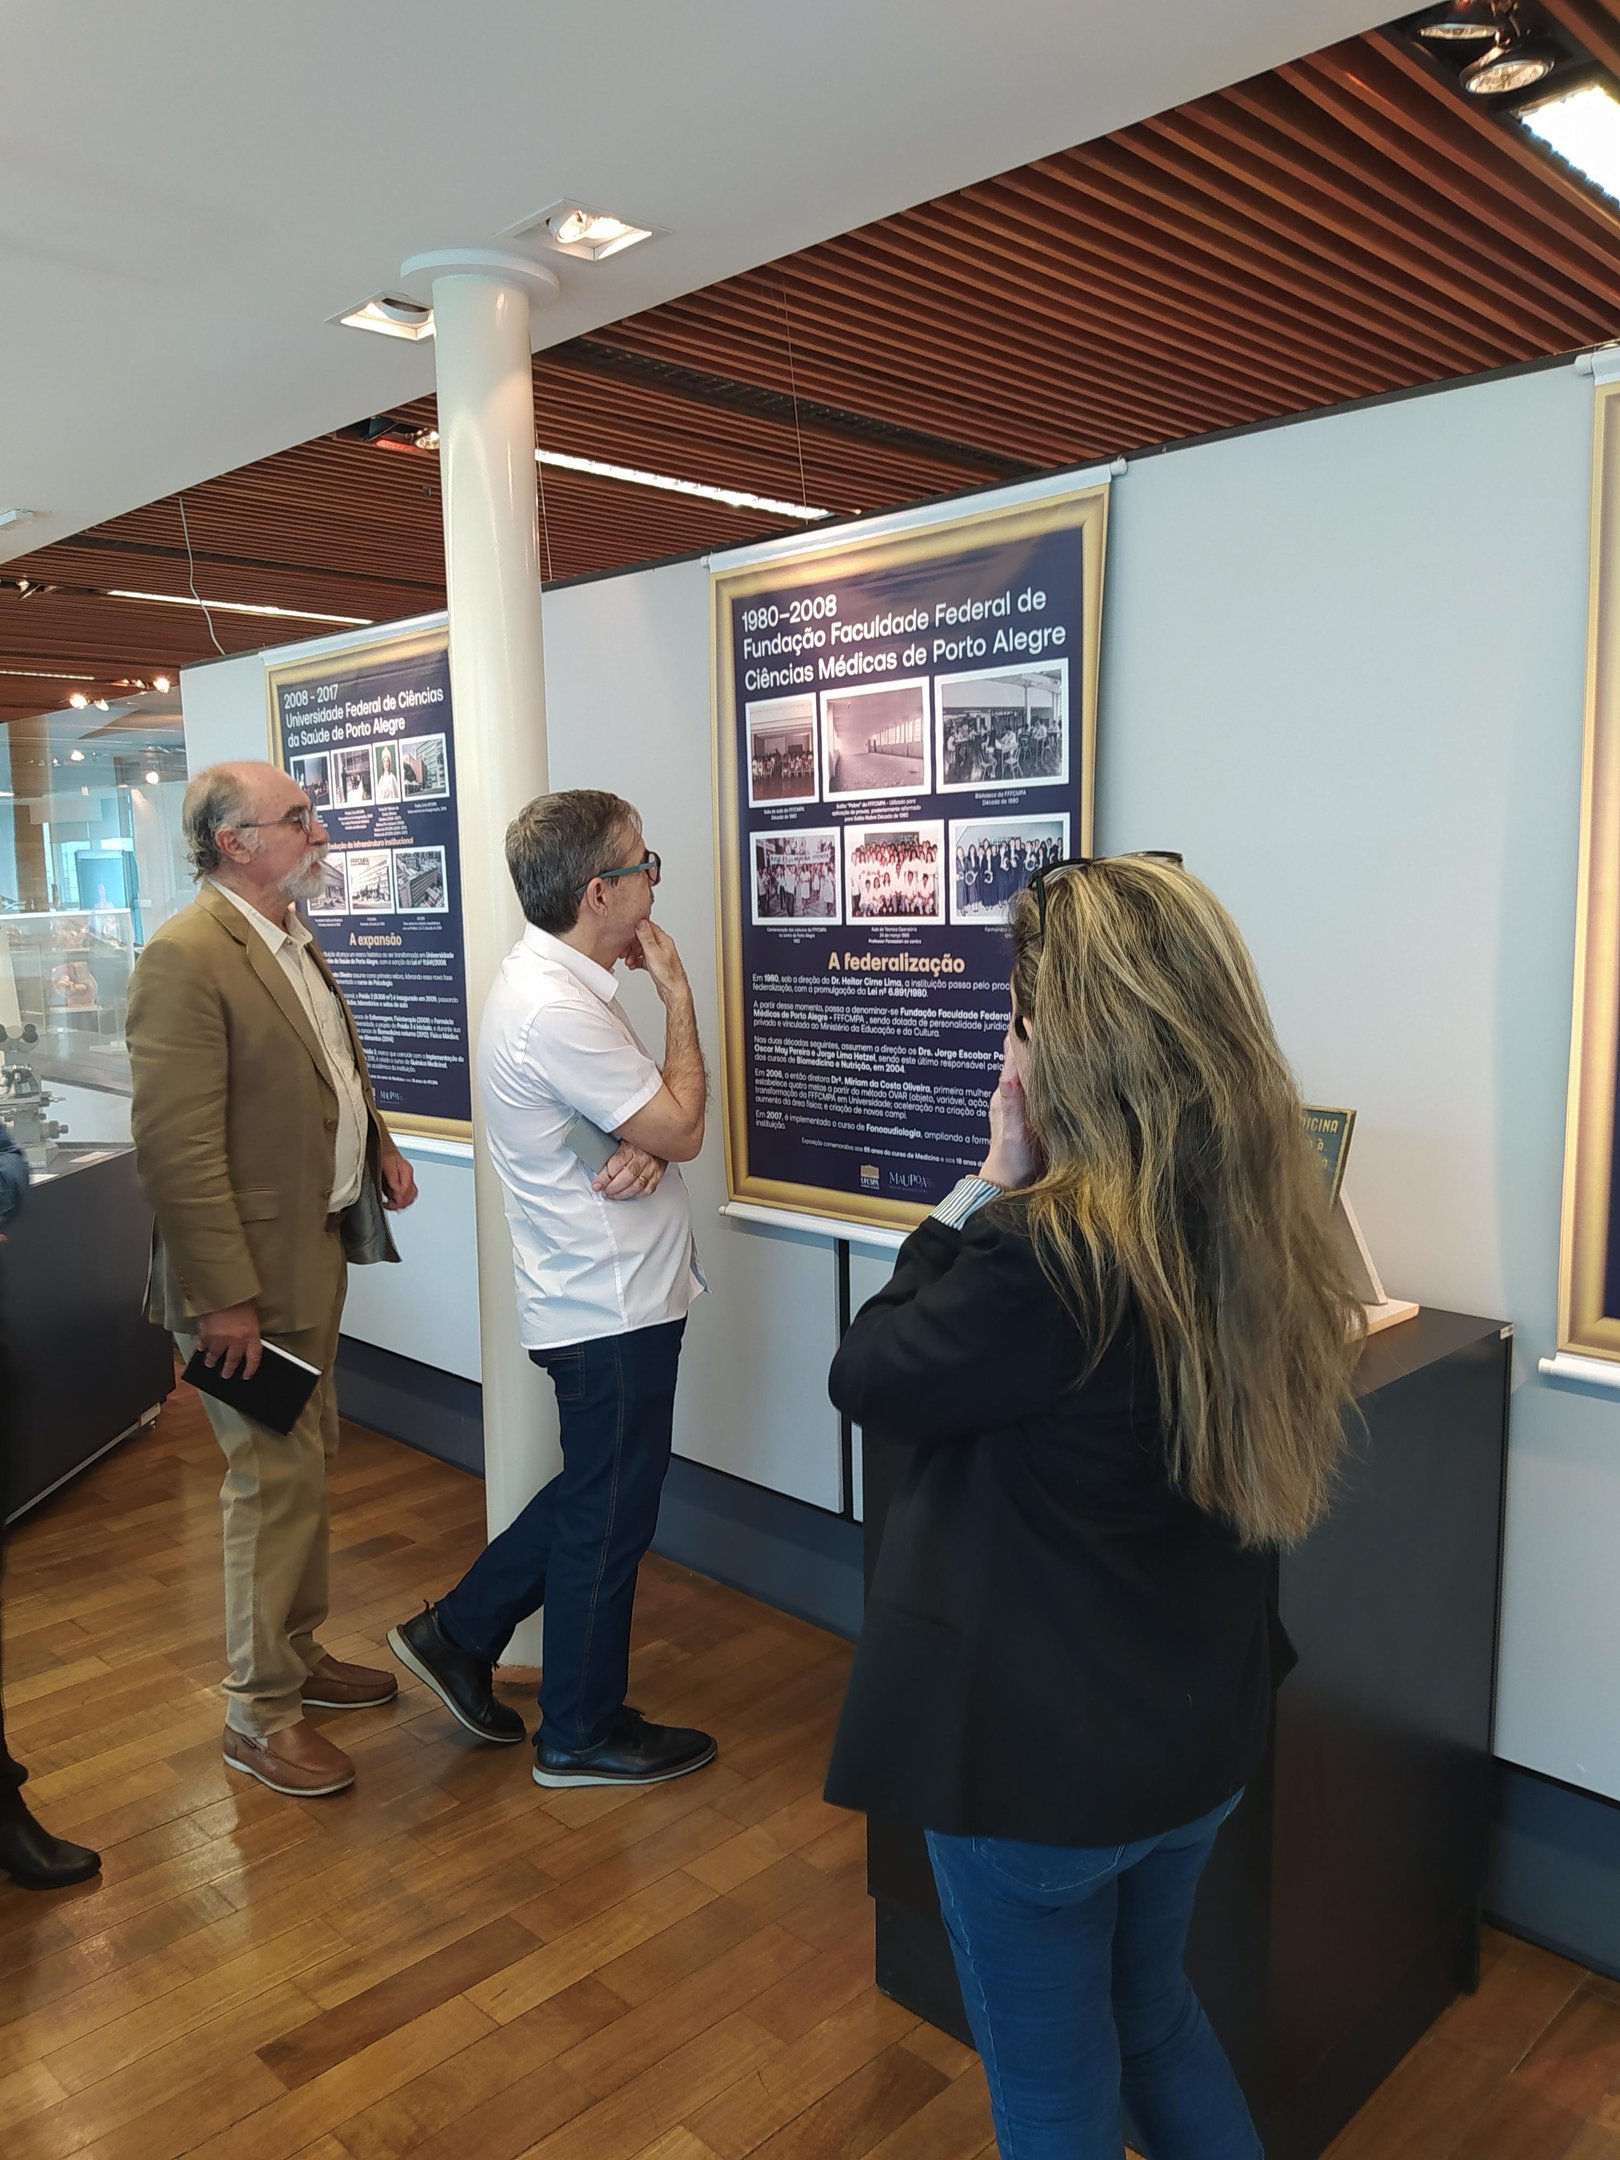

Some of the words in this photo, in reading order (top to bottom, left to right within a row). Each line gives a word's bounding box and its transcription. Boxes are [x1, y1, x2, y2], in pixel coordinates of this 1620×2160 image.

[743, 627, 826, 660] Fundação
[831, 608, 929, 645] Faculdade
[935, 590, 1010, 628] Federal
[1018, 586, 1046, 613] de
[745, 663, 814, 690] Ciências
[818, 651, 898, 680] Médicas
[903, 643, 927, 667] de
[933, 635, 986, 663] Porto
[992, 625, 1066, 655] Alegre
[284, 690, 308, 709] 2008
[317, 684, 338, 703] 2017
[286, 705, 343, 728] Universidade
[345, 697, 381, 719] Federal
[383, 694, 396, 710] de
[398, 686, 444, 708] Ciências
[288, 733, 299, 748] da
[301, 728, 330, 745] Saúde
[332, 726, 344, 741] de
[346, 722, 371, 739] Porto
[373, 716, 405, 736] Alegre
[349, 933, 357, 945] A
[358, 932, 402, 949] expansão
[828, 953, 840, 970] A
[845, 952, 965, 977] federalização
[856, 987, 866, 995] da
[850, 1024, 860, 1032] da
[903, 1027, 913, 1035] da
[918, 1019, 928, 1027] de
[754, 1068, 765, 1076] Em
[869, 1080, 879, 1088] da
[756, 1110, 766, 1118] Em
[856, 1122, 865, 1130] de
